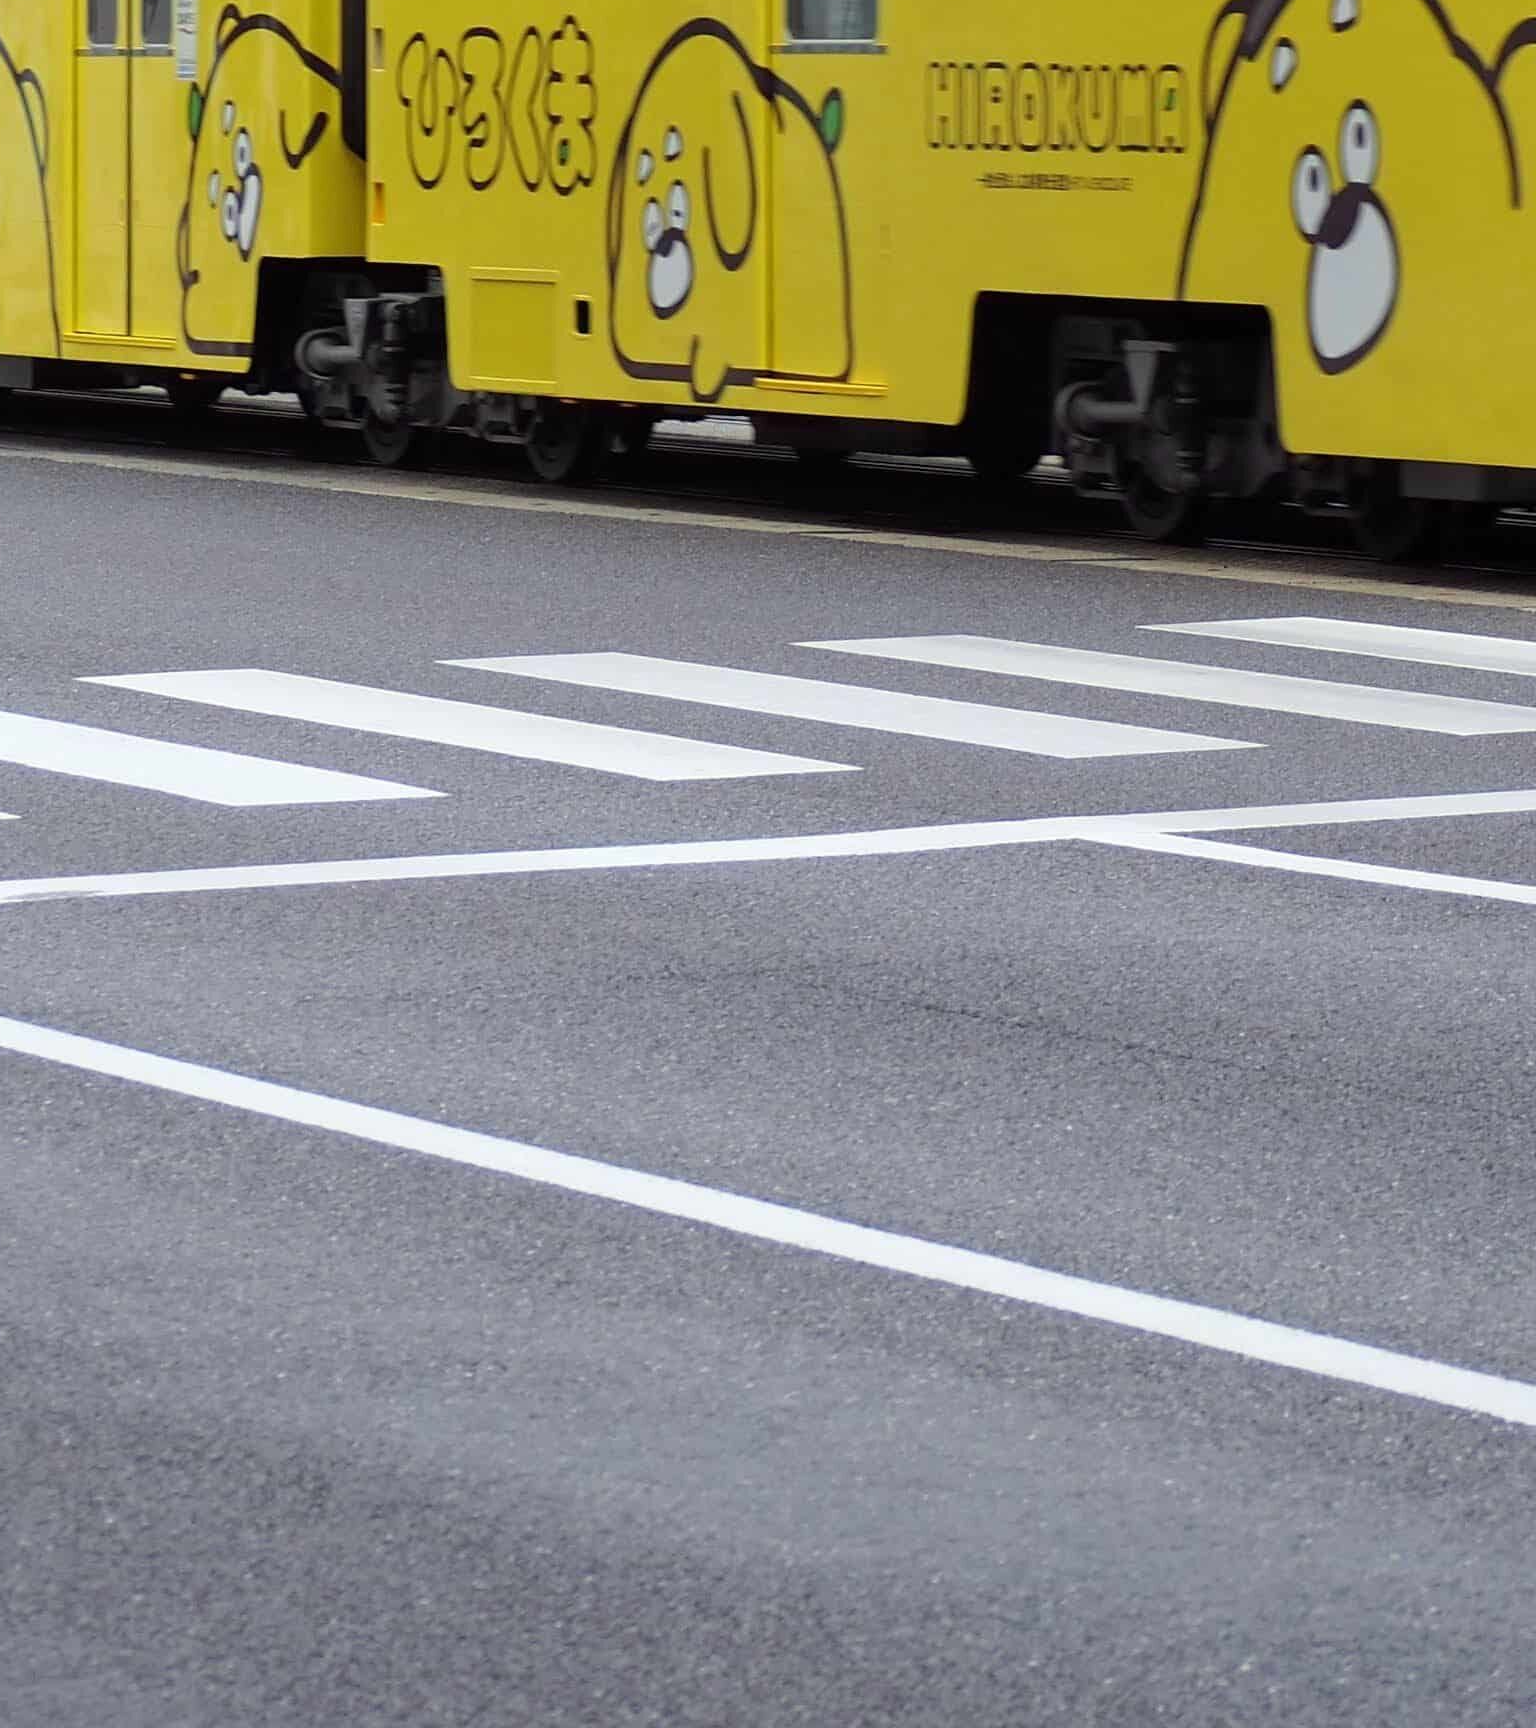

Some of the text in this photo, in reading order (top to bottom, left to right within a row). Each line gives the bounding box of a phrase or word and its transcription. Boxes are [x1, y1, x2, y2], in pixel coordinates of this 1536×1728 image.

[396, 14, 599, 197] ひろくま
[925, 60, 1188, 155] HIROKUMA
